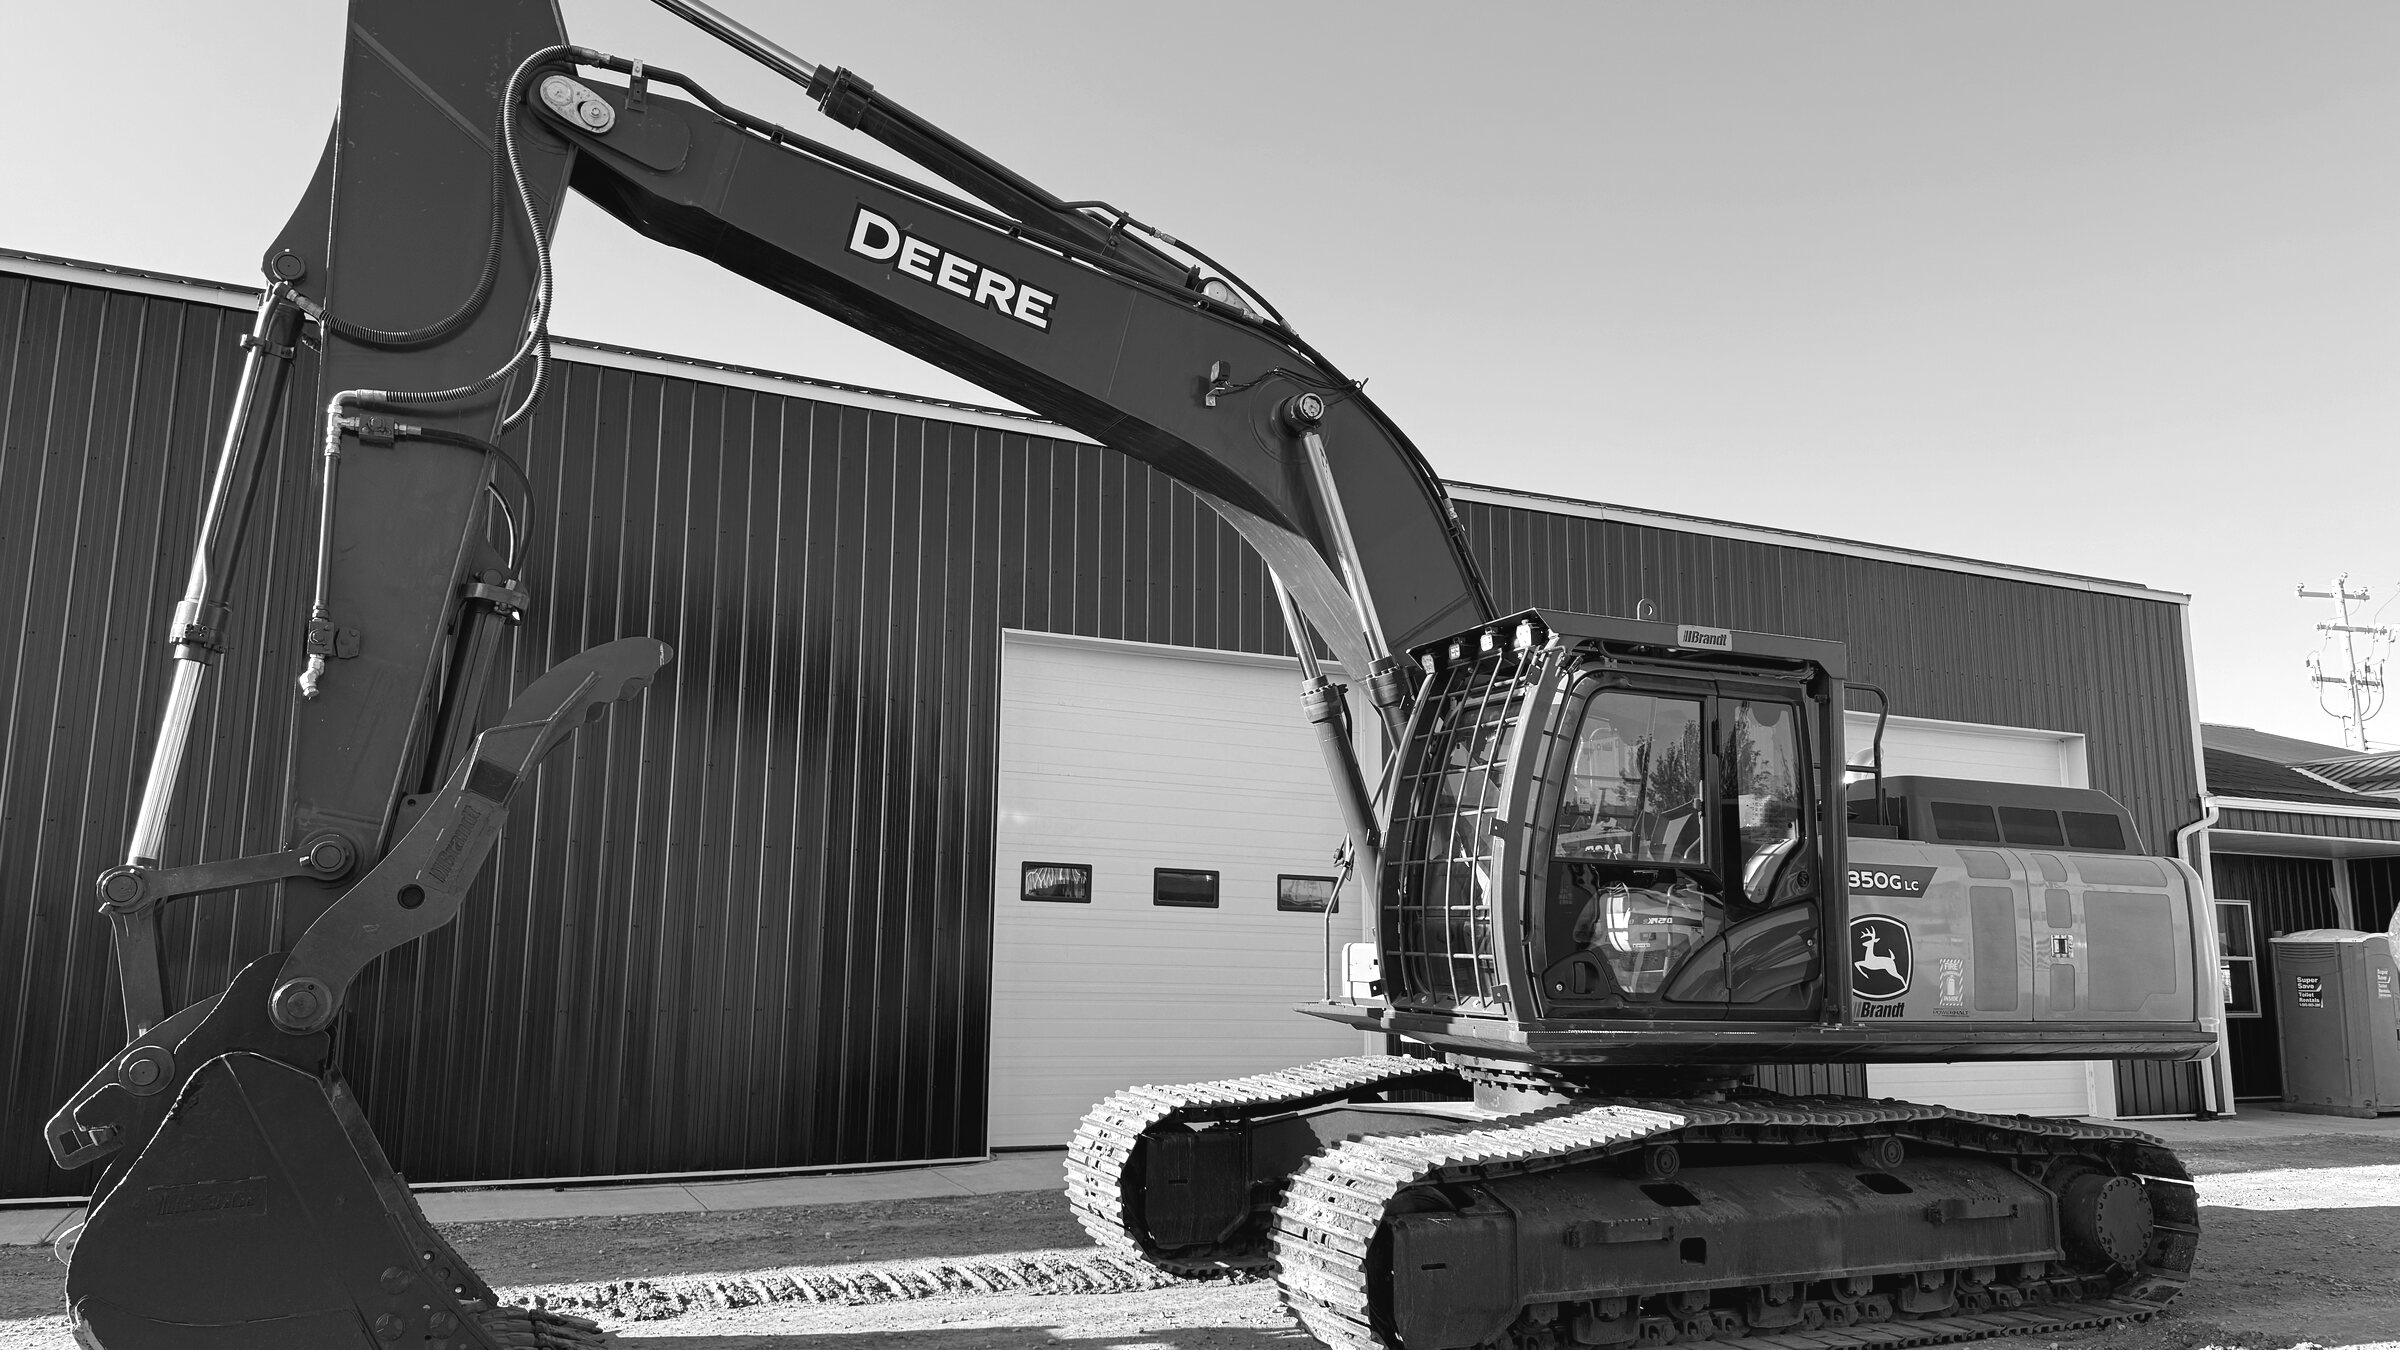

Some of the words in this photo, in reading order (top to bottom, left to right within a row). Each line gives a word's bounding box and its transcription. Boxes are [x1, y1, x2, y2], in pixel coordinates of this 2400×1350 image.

[848, 206, 1055, 330] DEERE
[1690, 630, 1727, 646] Brandt
[1848, 870, 1902, 890] 350G
[1904, 880, 1920, 891] LC
[2296, 976, 2319, 984] Super
[1861, 1001, 1905, 1018] Brandt
